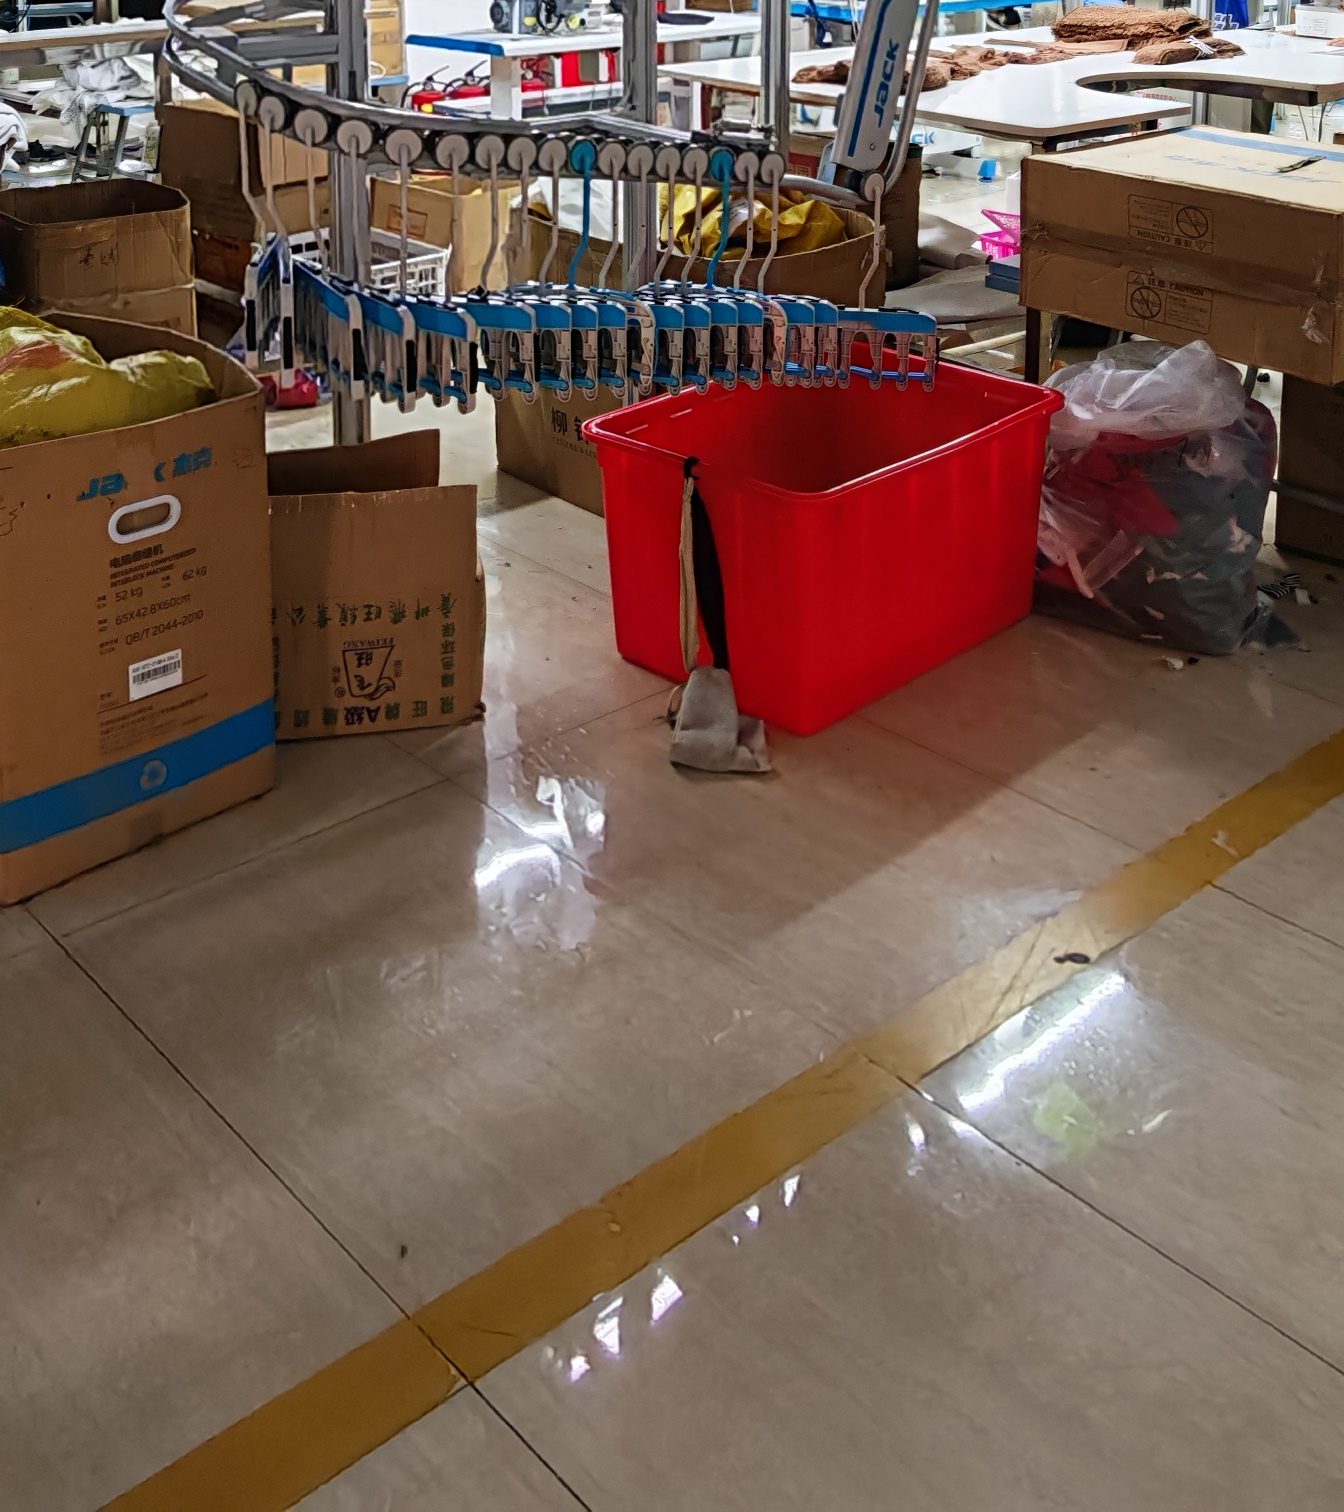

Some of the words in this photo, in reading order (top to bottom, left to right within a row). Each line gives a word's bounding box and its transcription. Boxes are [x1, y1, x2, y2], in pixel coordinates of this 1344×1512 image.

[1137, 229, 1171, 244] CAUTION
[1169, 282, 1205, 297] CAUTION
[172, 446, 213, 477] 杰克
[110, 561, 150, 580] INTEGRATED
[110, 572, 145, 589] INTERLOCK
[146, 563, 174, 579] MACHINE
[125, 628, 151, 646] QB/T
[152, 609, 204, 637] 2044-2010
[343, 638, 394, 650] FEIWANG
